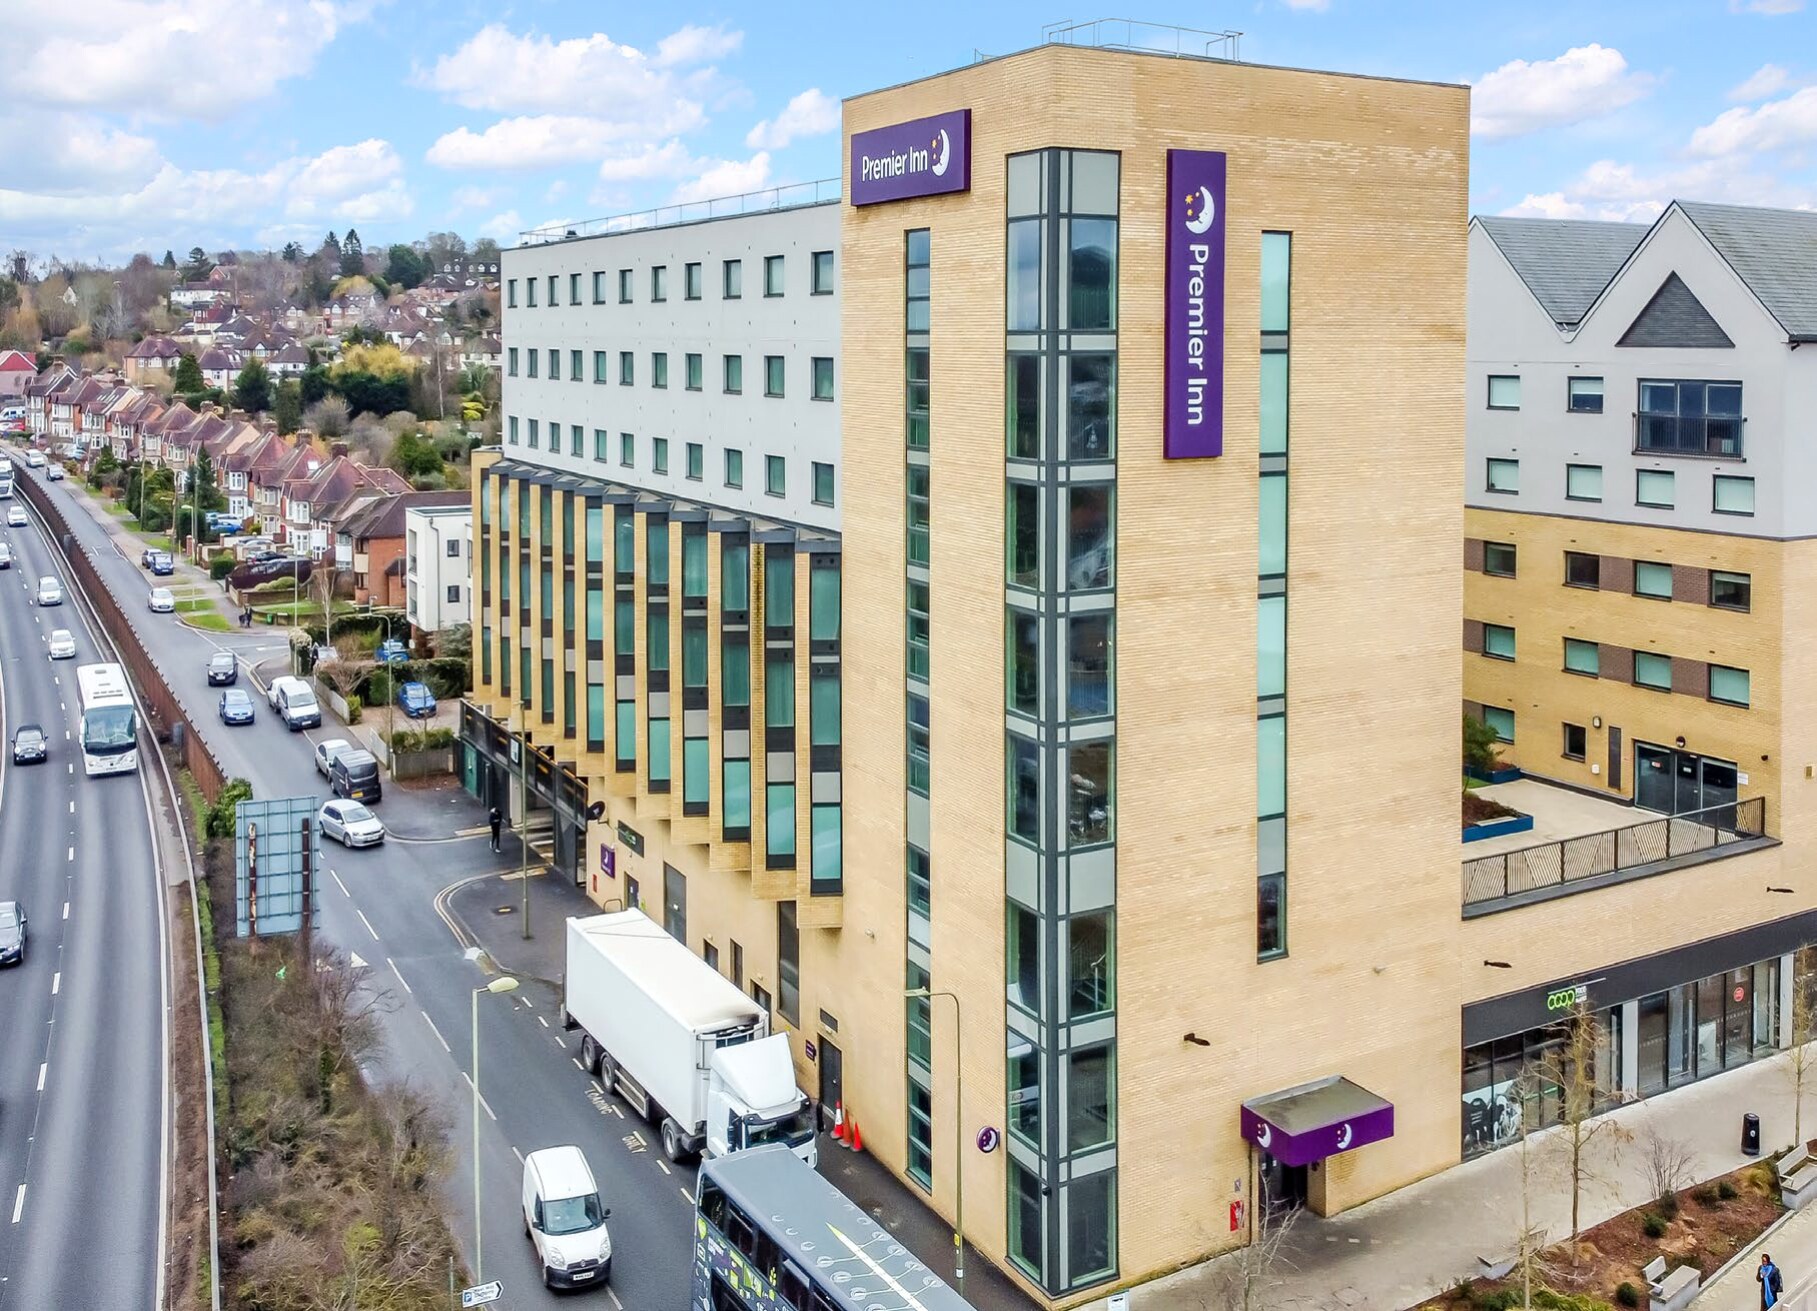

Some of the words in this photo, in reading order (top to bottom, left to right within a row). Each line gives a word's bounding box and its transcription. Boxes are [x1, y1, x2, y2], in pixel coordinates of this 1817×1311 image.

[862, 150, 907, 182] Premier
[909, 146, 928, 173] Inn
[1188, 245, 1209, 371] Premier
[1187, 378, 1208, 425] Inn
[621, 1135, 647, 1154] ONLY
